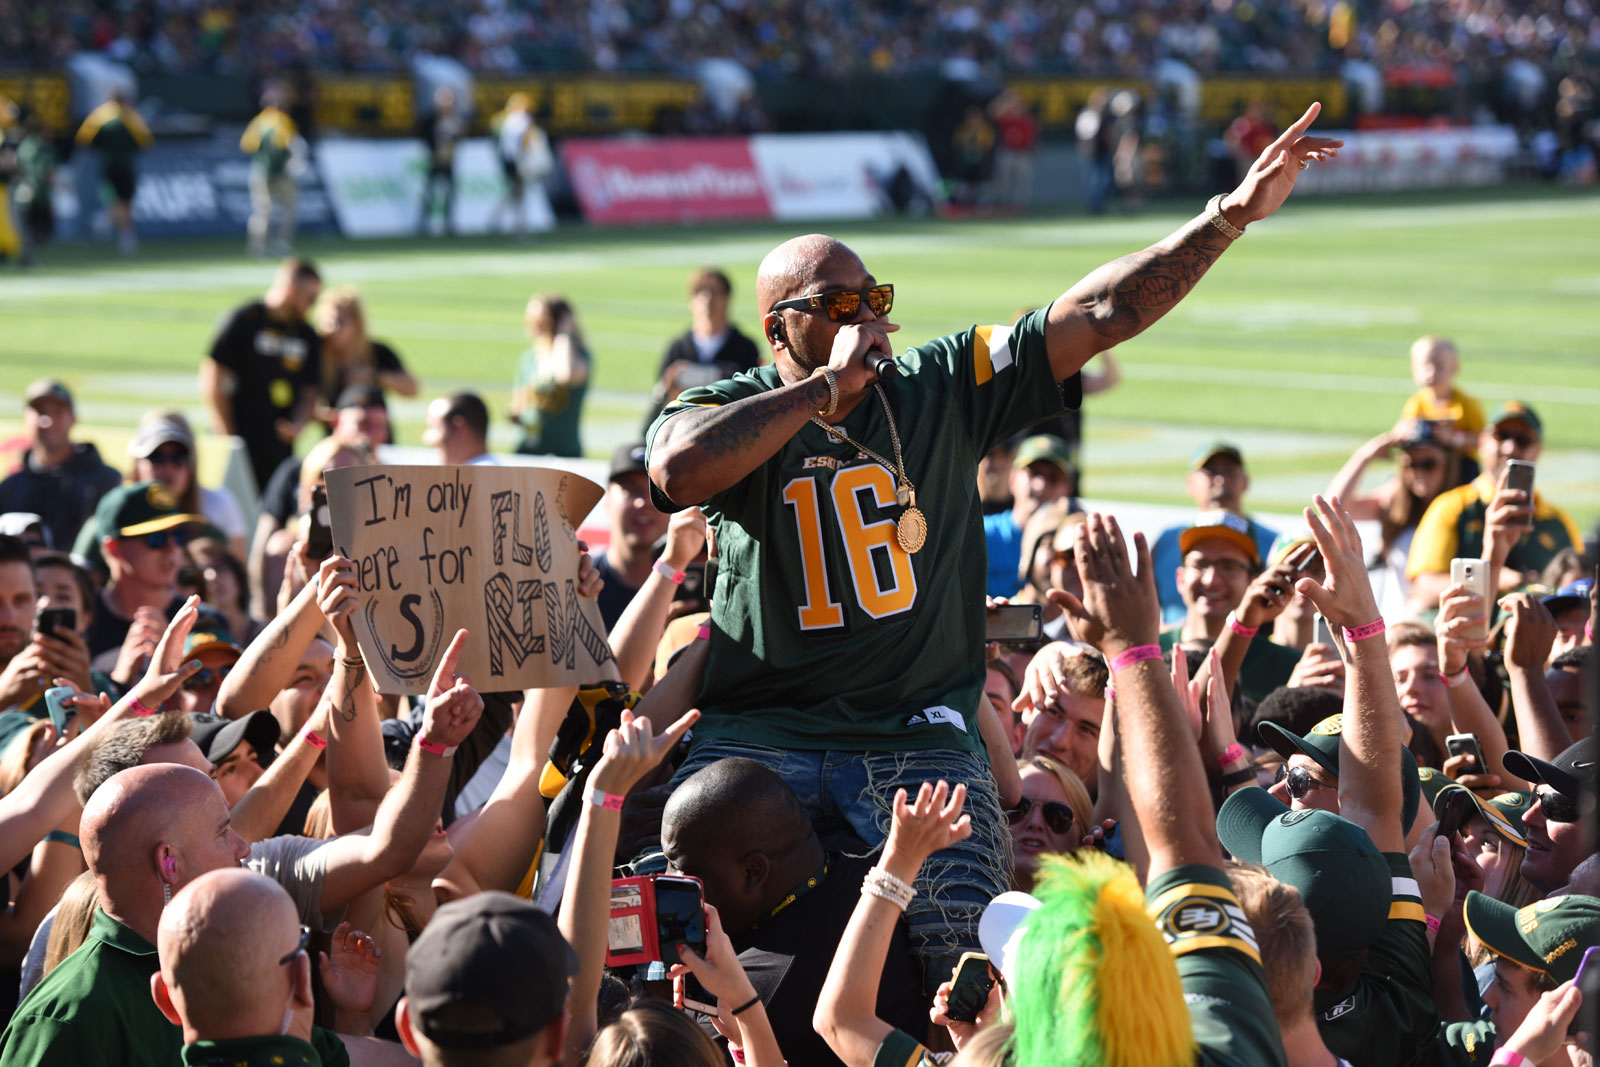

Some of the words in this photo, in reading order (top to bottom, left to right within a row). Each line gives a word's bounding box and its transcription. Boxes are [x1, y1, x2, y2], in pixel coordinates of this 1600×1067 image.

[354, 474, 411, 526] I'm
[427, 468, 472, 528] only
[419, 526, 473, 585] for
[490, 489, 552, 574] FLO
[782, 463, 917, 630] 16
[484, 571, 612, 676] RIDA
[930, 711, 946, 719] XL
[1543, 937, 1579, 965] Reebok
